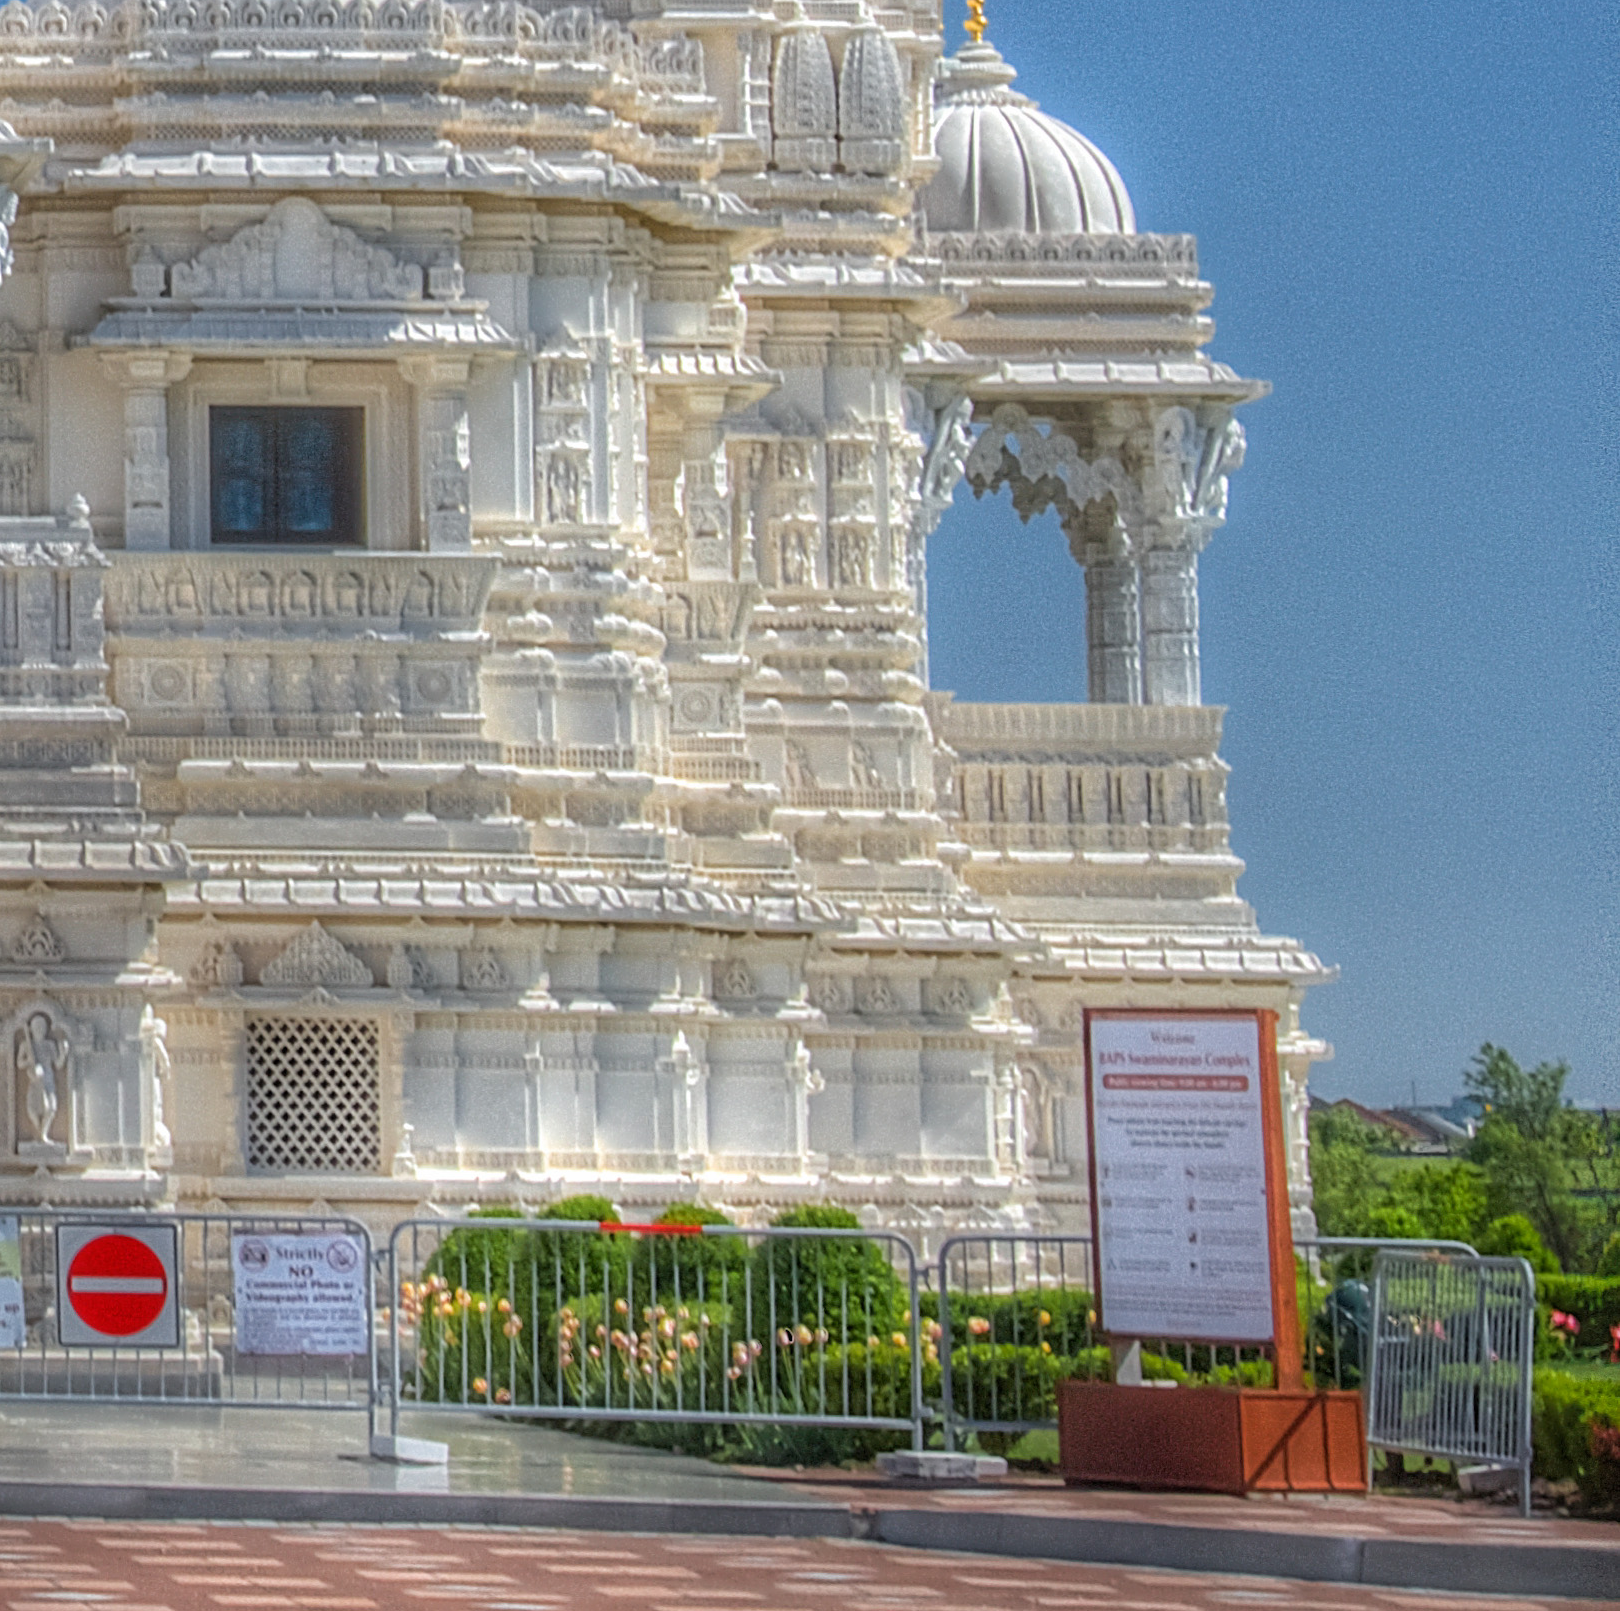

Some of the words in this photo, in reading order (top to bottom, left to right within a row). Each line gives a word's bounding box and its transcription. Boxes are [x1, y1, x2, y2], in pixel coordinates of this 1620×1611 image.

[276, 1248, 323, 1260] Strictly
[289, 1266, 313, 1278] NO
[245, 1280, 307, 1289] Commercial
[311, 1280, 340, 1289] Photo
[245, 1292, 309, 1304] Videography
[4, 1304, 20, 1314] up
